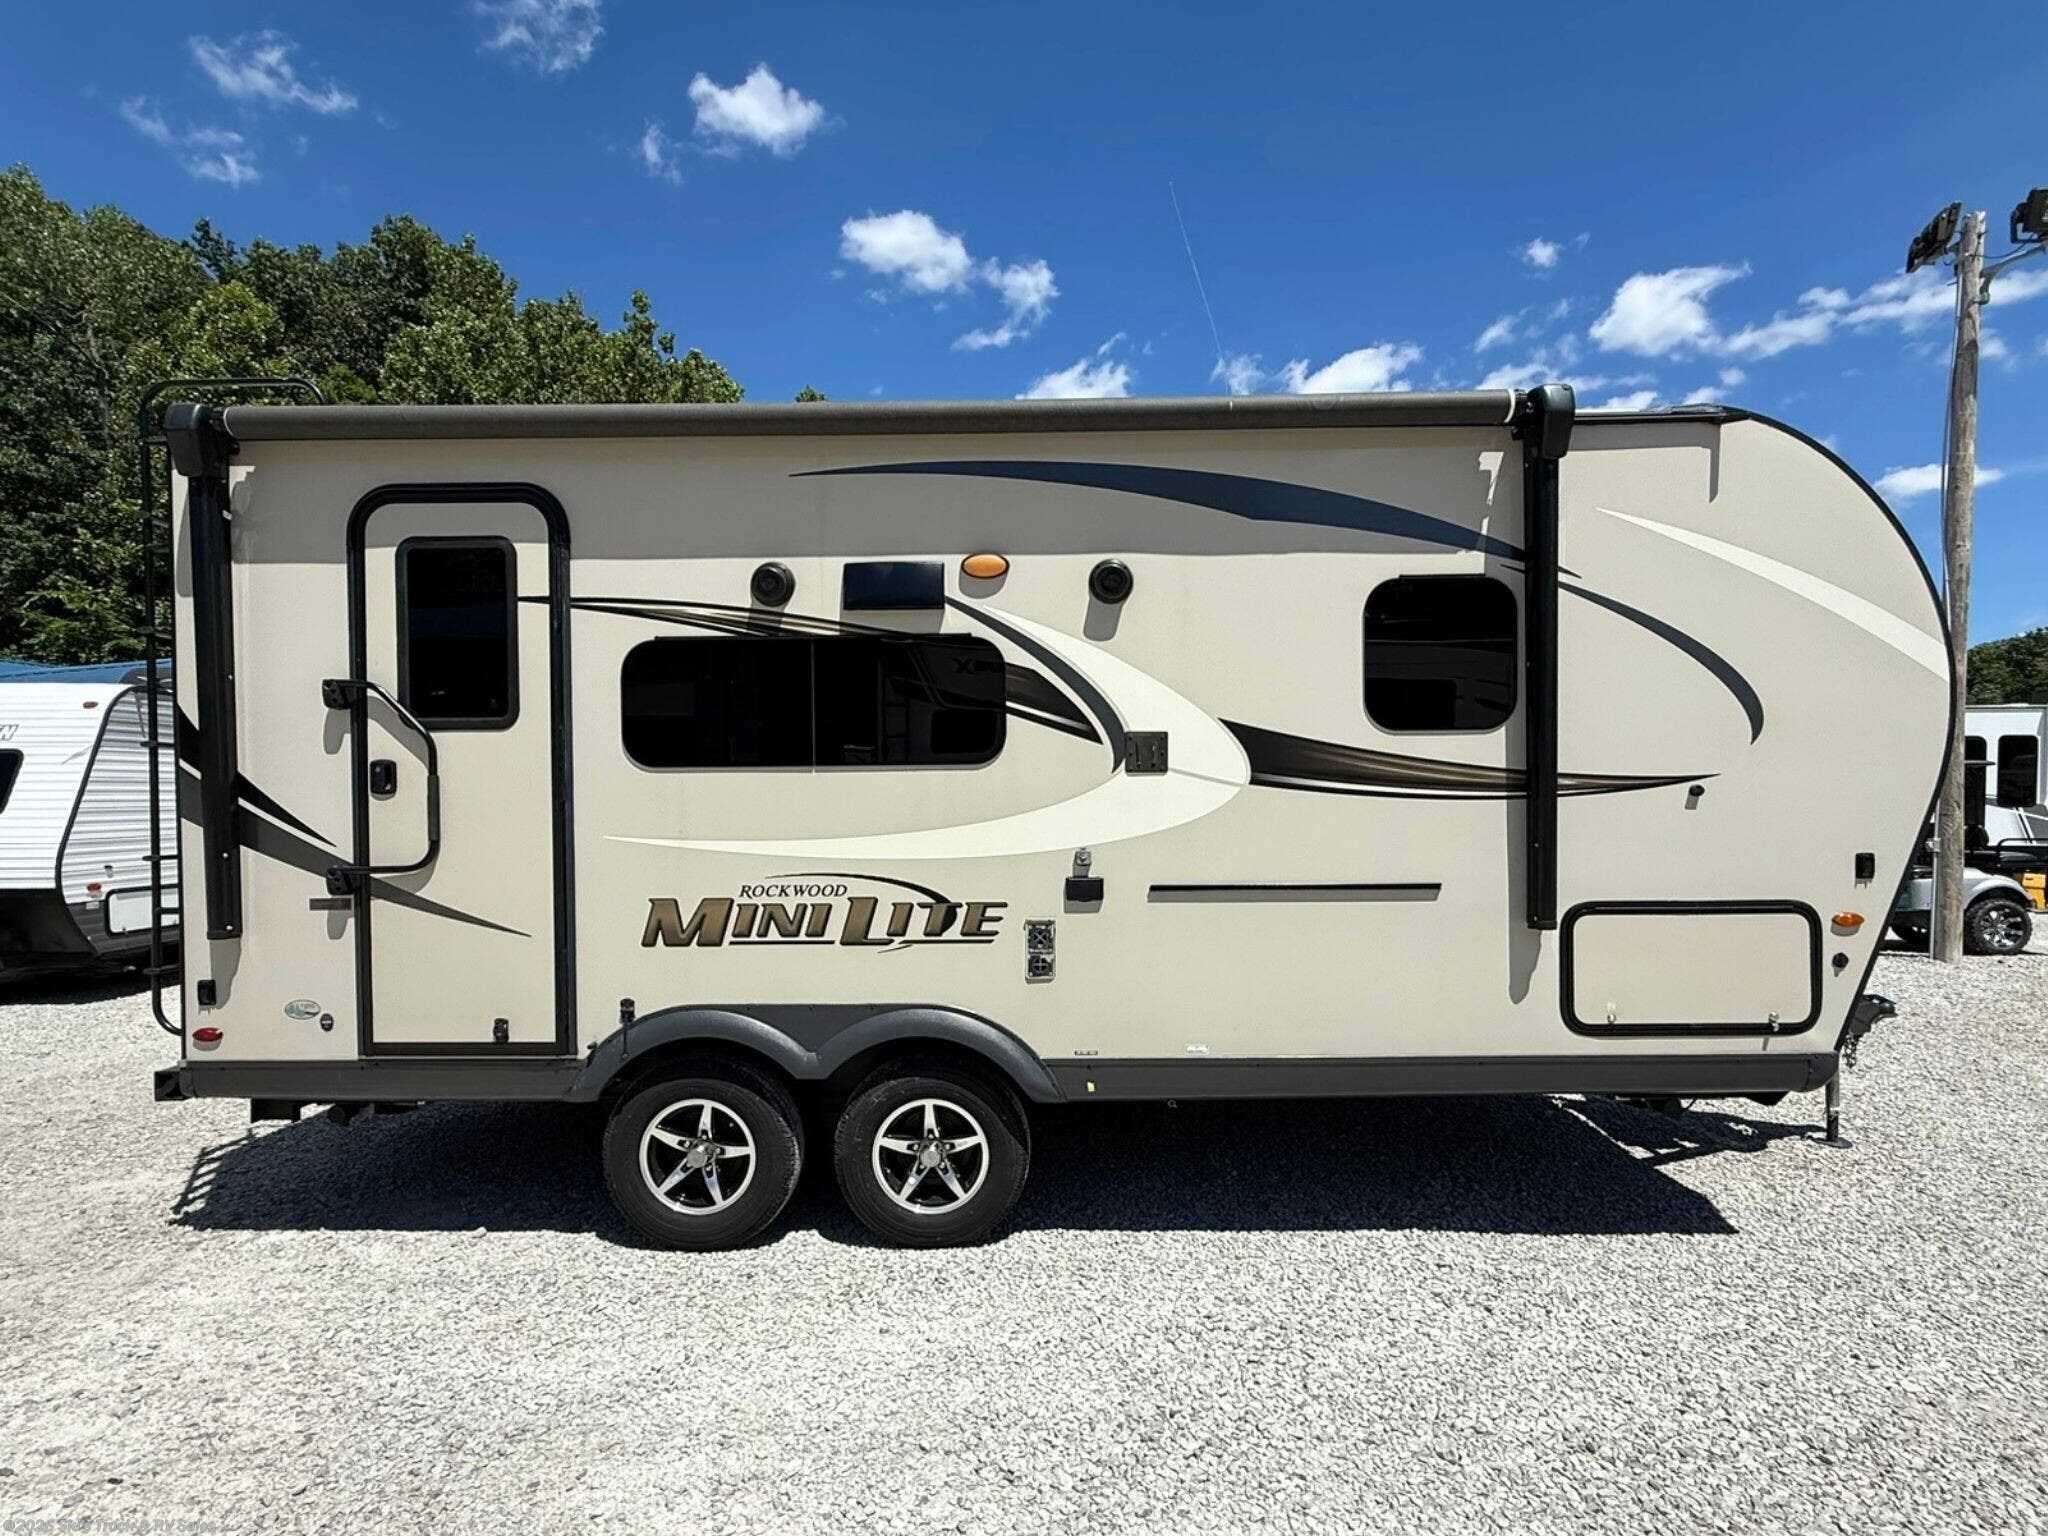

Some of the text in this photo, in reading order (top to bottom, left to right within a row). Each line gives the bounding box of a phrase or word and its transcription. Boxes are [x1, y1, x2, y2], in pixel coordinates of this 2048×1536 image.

[740, 884, 848, 899] ROCKWOOD
[641, 896, 1008, 948] MINI LITE
